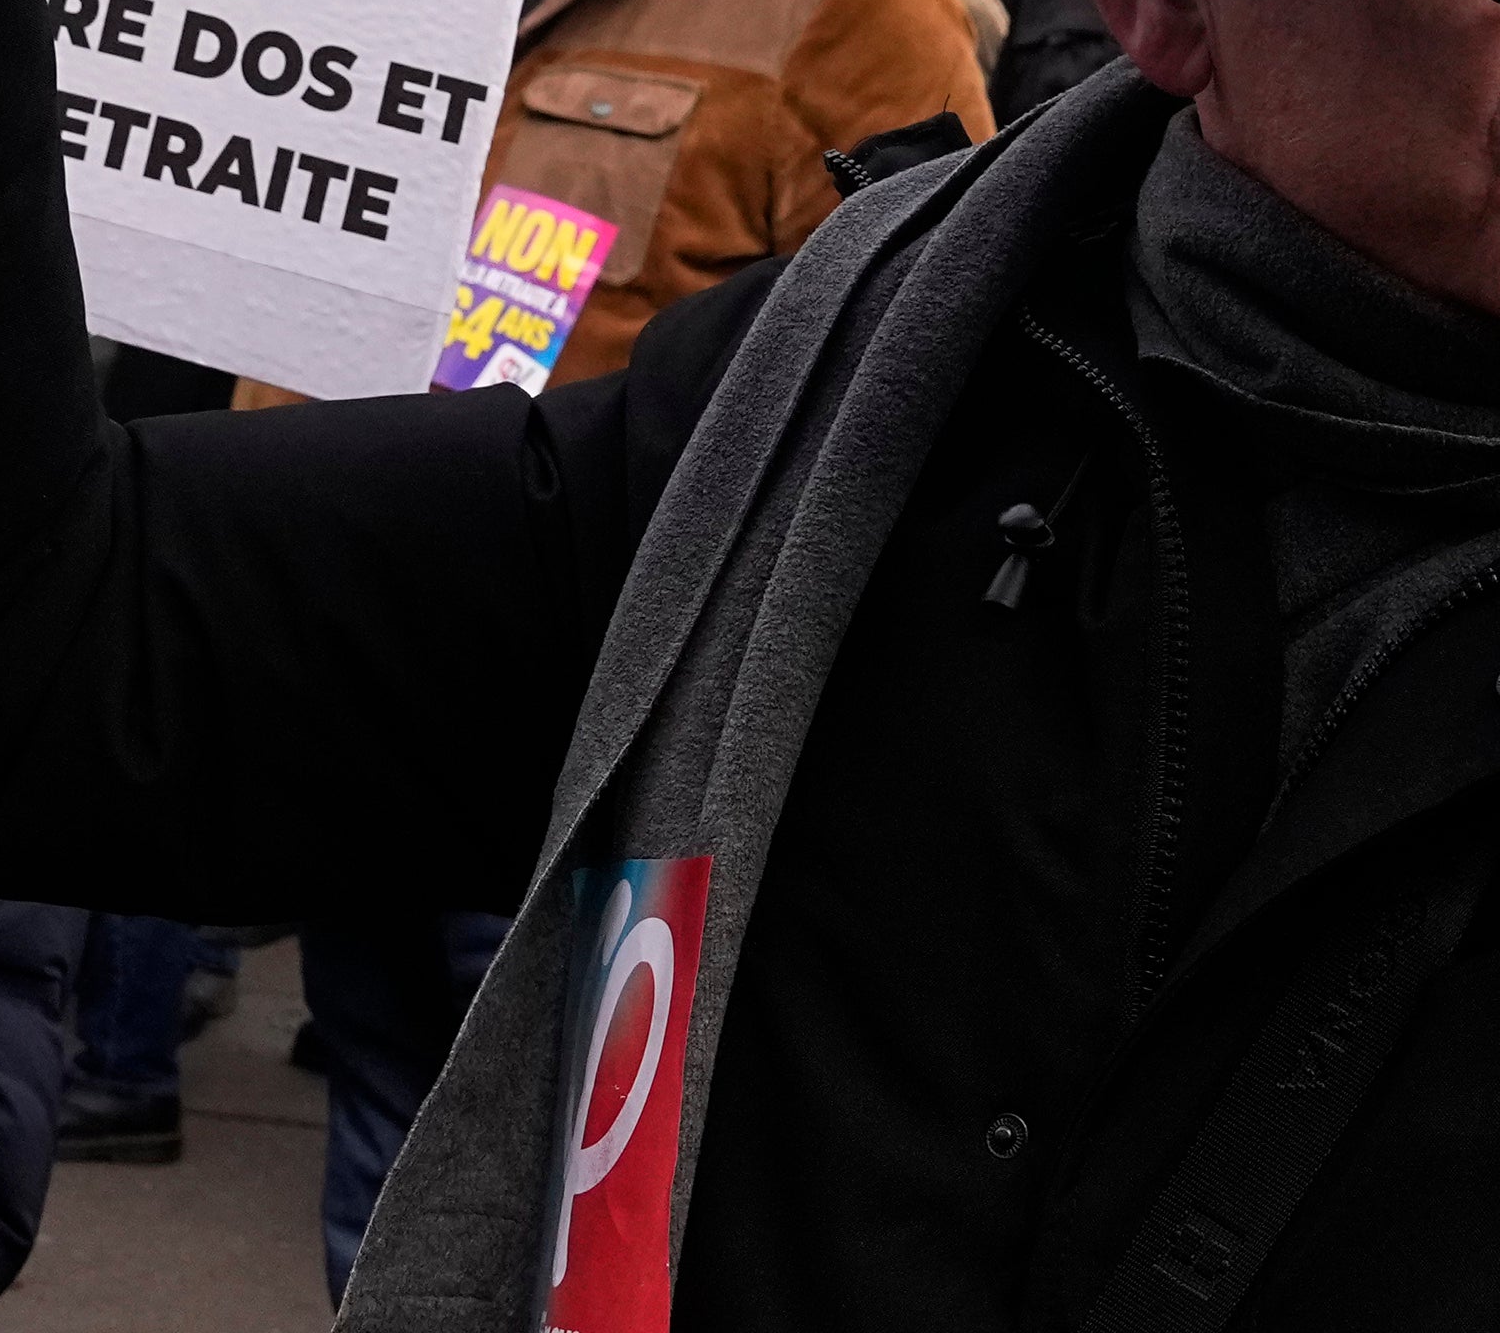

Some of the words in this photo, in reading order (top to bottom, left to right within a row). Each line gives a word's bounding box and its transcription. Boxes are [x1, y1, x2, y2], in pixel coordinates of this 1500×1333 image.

[174, 10, 357, 111] DOS
[378, 62, 488, 144] ET
[469, 198, 599, 291] NON
[495, 304, 556, 351] ANS
